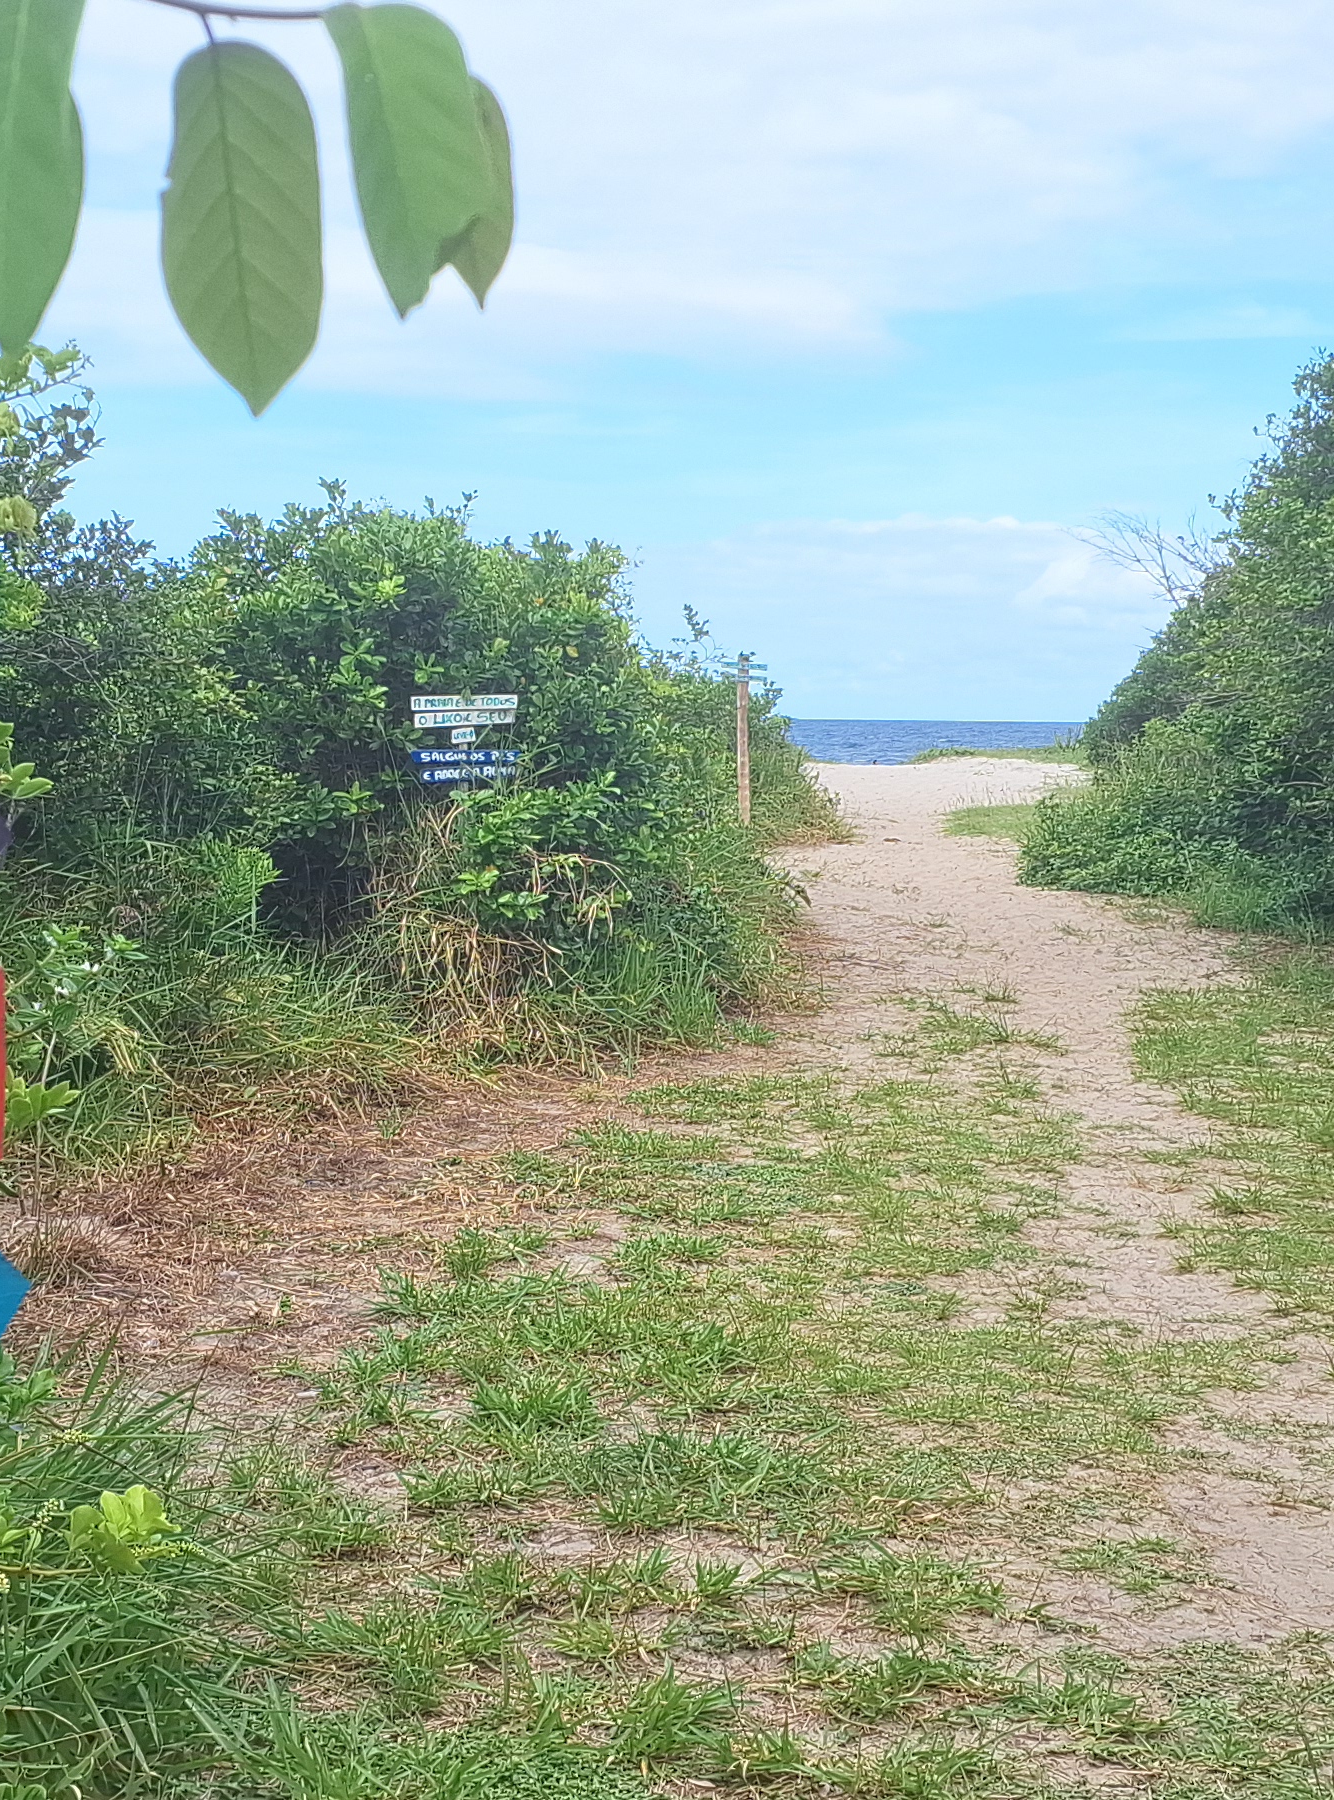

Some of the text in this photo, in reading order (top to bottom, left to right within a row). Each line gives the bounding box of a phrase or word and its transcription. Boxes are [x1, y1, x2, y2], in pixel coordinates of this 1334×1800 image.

[413, 698, 421, 708] A
[480, 696, 516, 707] TODOS
[419, 716, 427, 725] O
[477, 711, 507, 723] SEU
[469, 752, 485, 761] OS
[489, 750, 515, 761] PS
[423, 771, 432, 780] E
